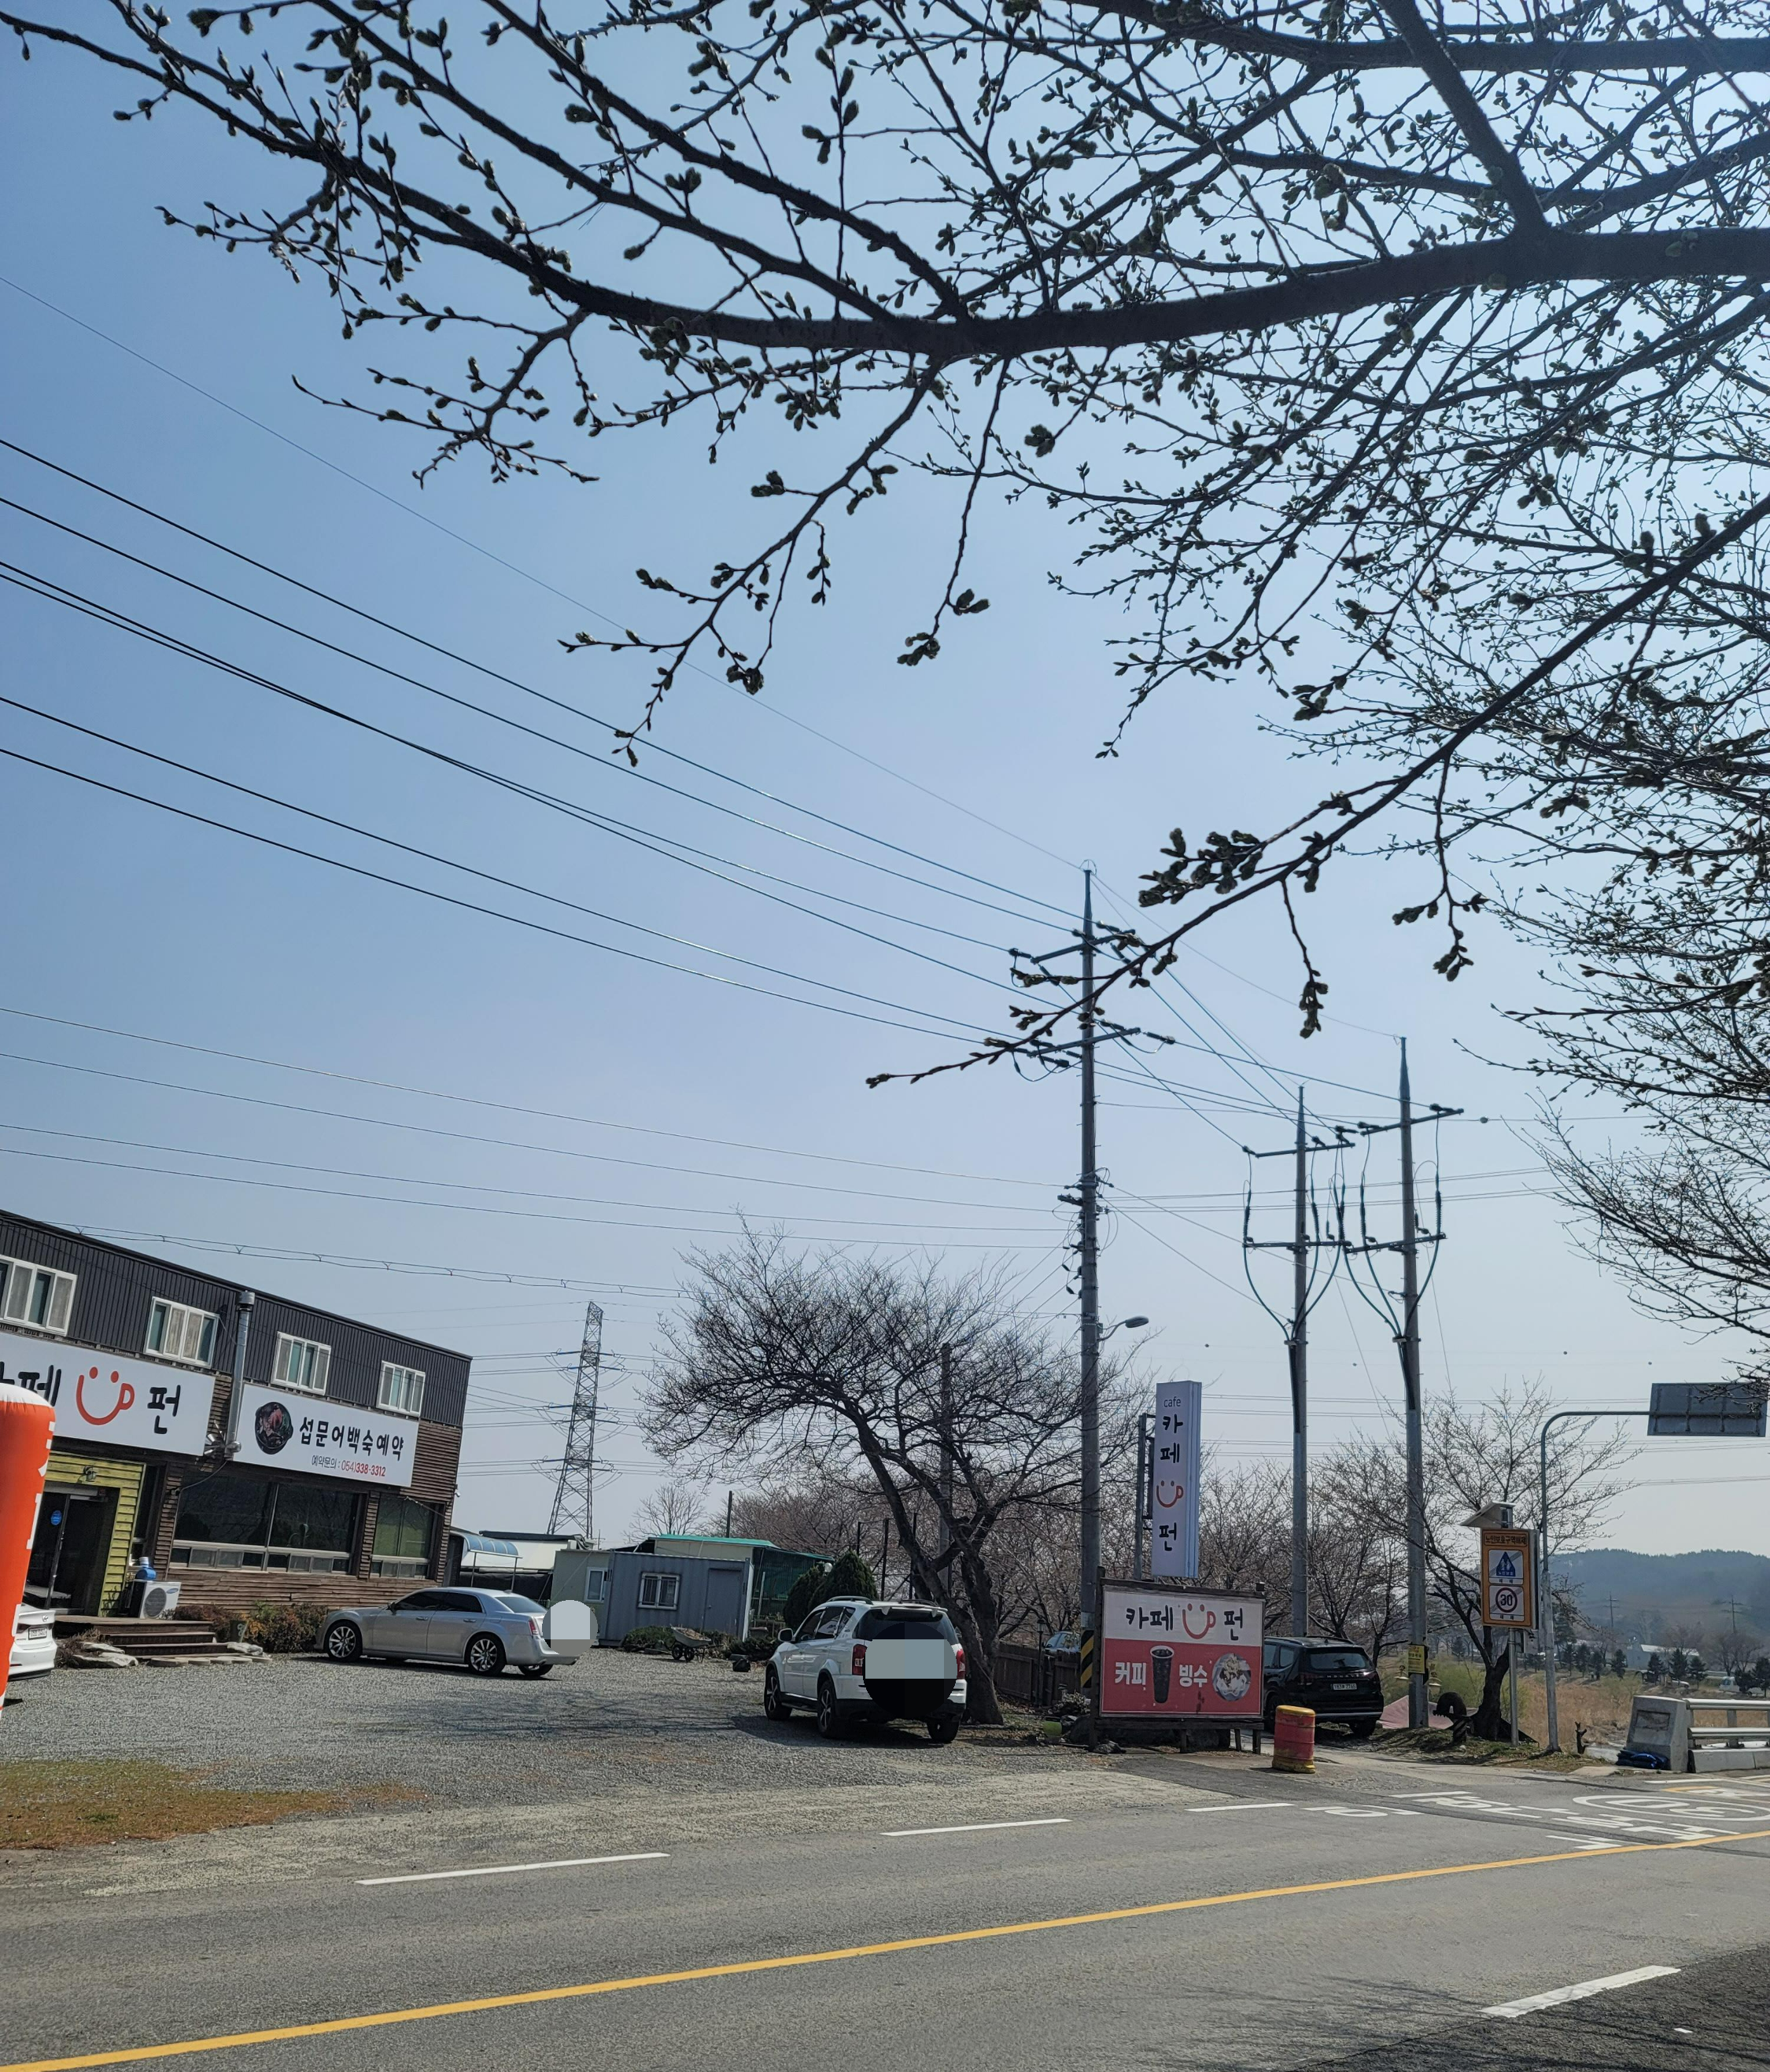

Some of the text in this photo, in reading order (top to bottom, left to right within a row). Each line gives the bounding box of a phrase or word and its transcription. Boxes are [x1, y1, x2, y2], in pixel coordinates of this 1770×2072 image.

[147, 1384, 181, 1434] 펀
[1163, 1396, 1182, 1407] cafe
[1160, 1414, 1183, 1463] 카페
[341, 1460, 386, 1477] 054)338-3312
[1159, 1522, 1177, 1551] 펀
[1500, 1595, 1513, 1606] 30
[1126, 1605, 1243, 1640] 카페 펀
[1115, 1662, 1208, 1687] 커피 빙수
